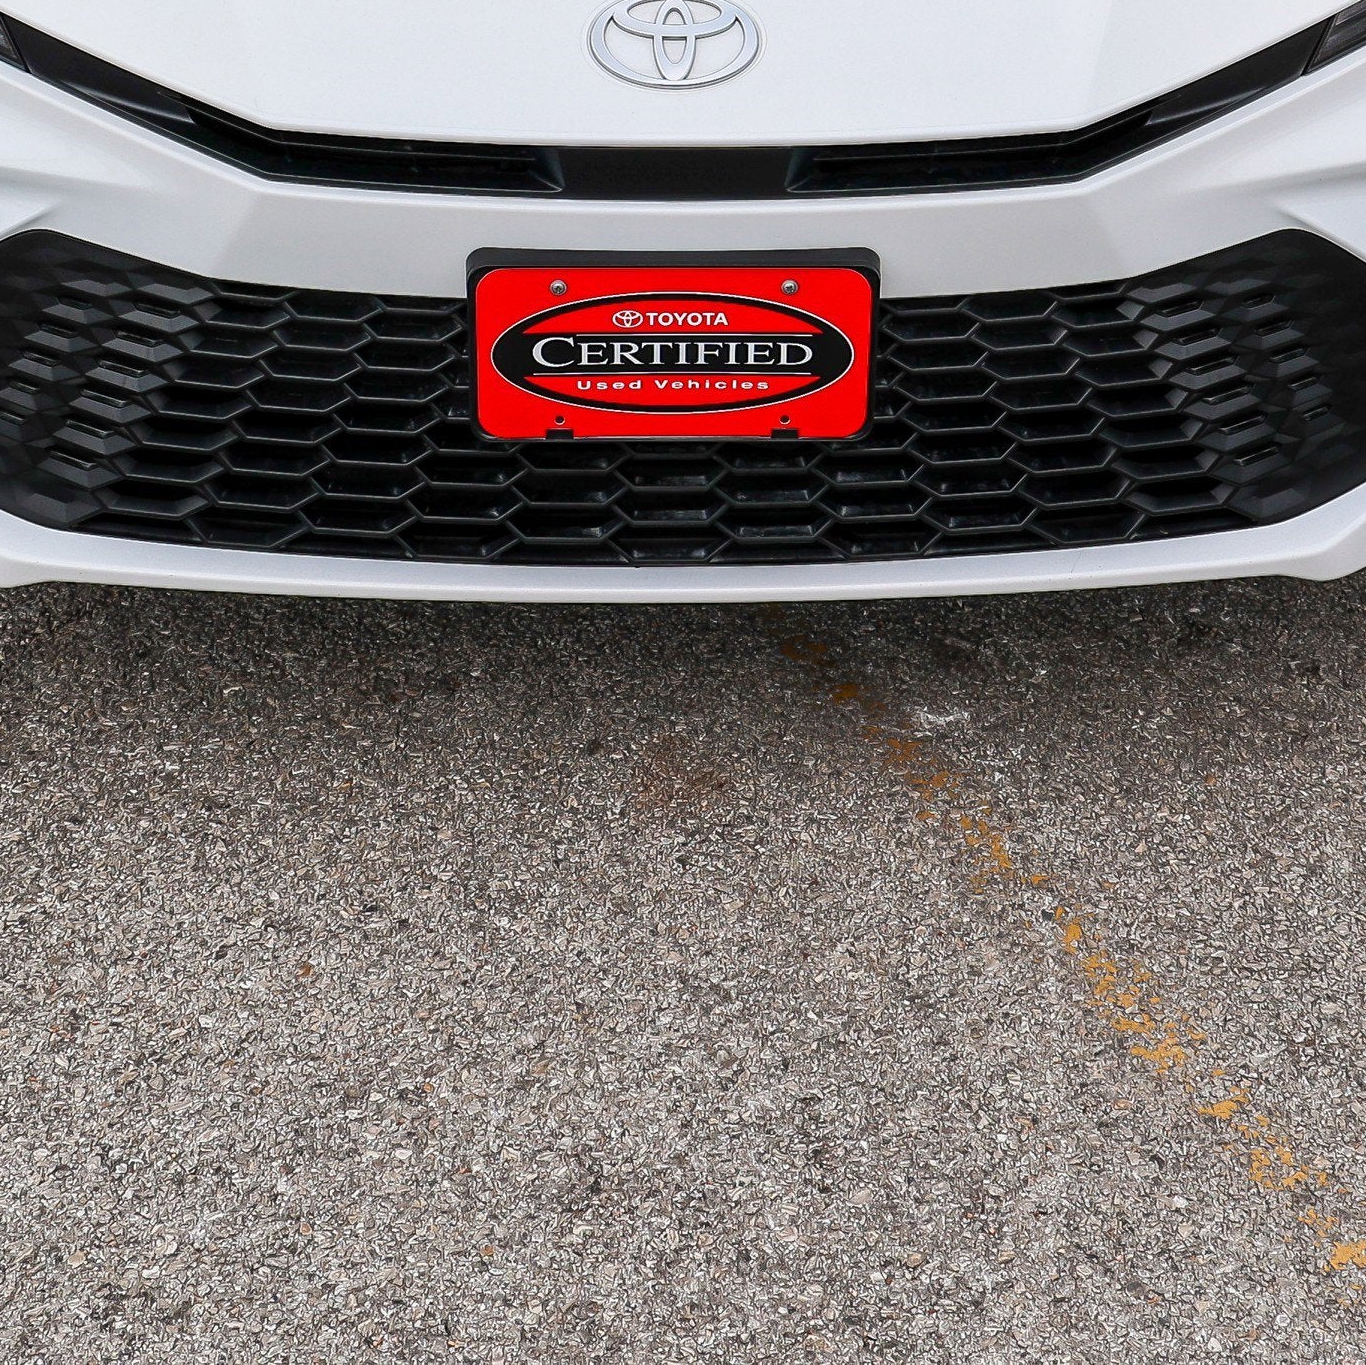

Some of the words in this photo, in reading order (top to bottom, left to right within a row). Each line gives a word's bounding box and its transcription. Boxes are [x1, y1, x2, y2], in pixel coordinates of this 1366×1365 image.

[646, 312, 729, 326] TOYOTA
[532, 337, 813, 368] CERTIFIED
[577, 380, 642, 390] Used
[654, 379, 770, 390] Vehicles
